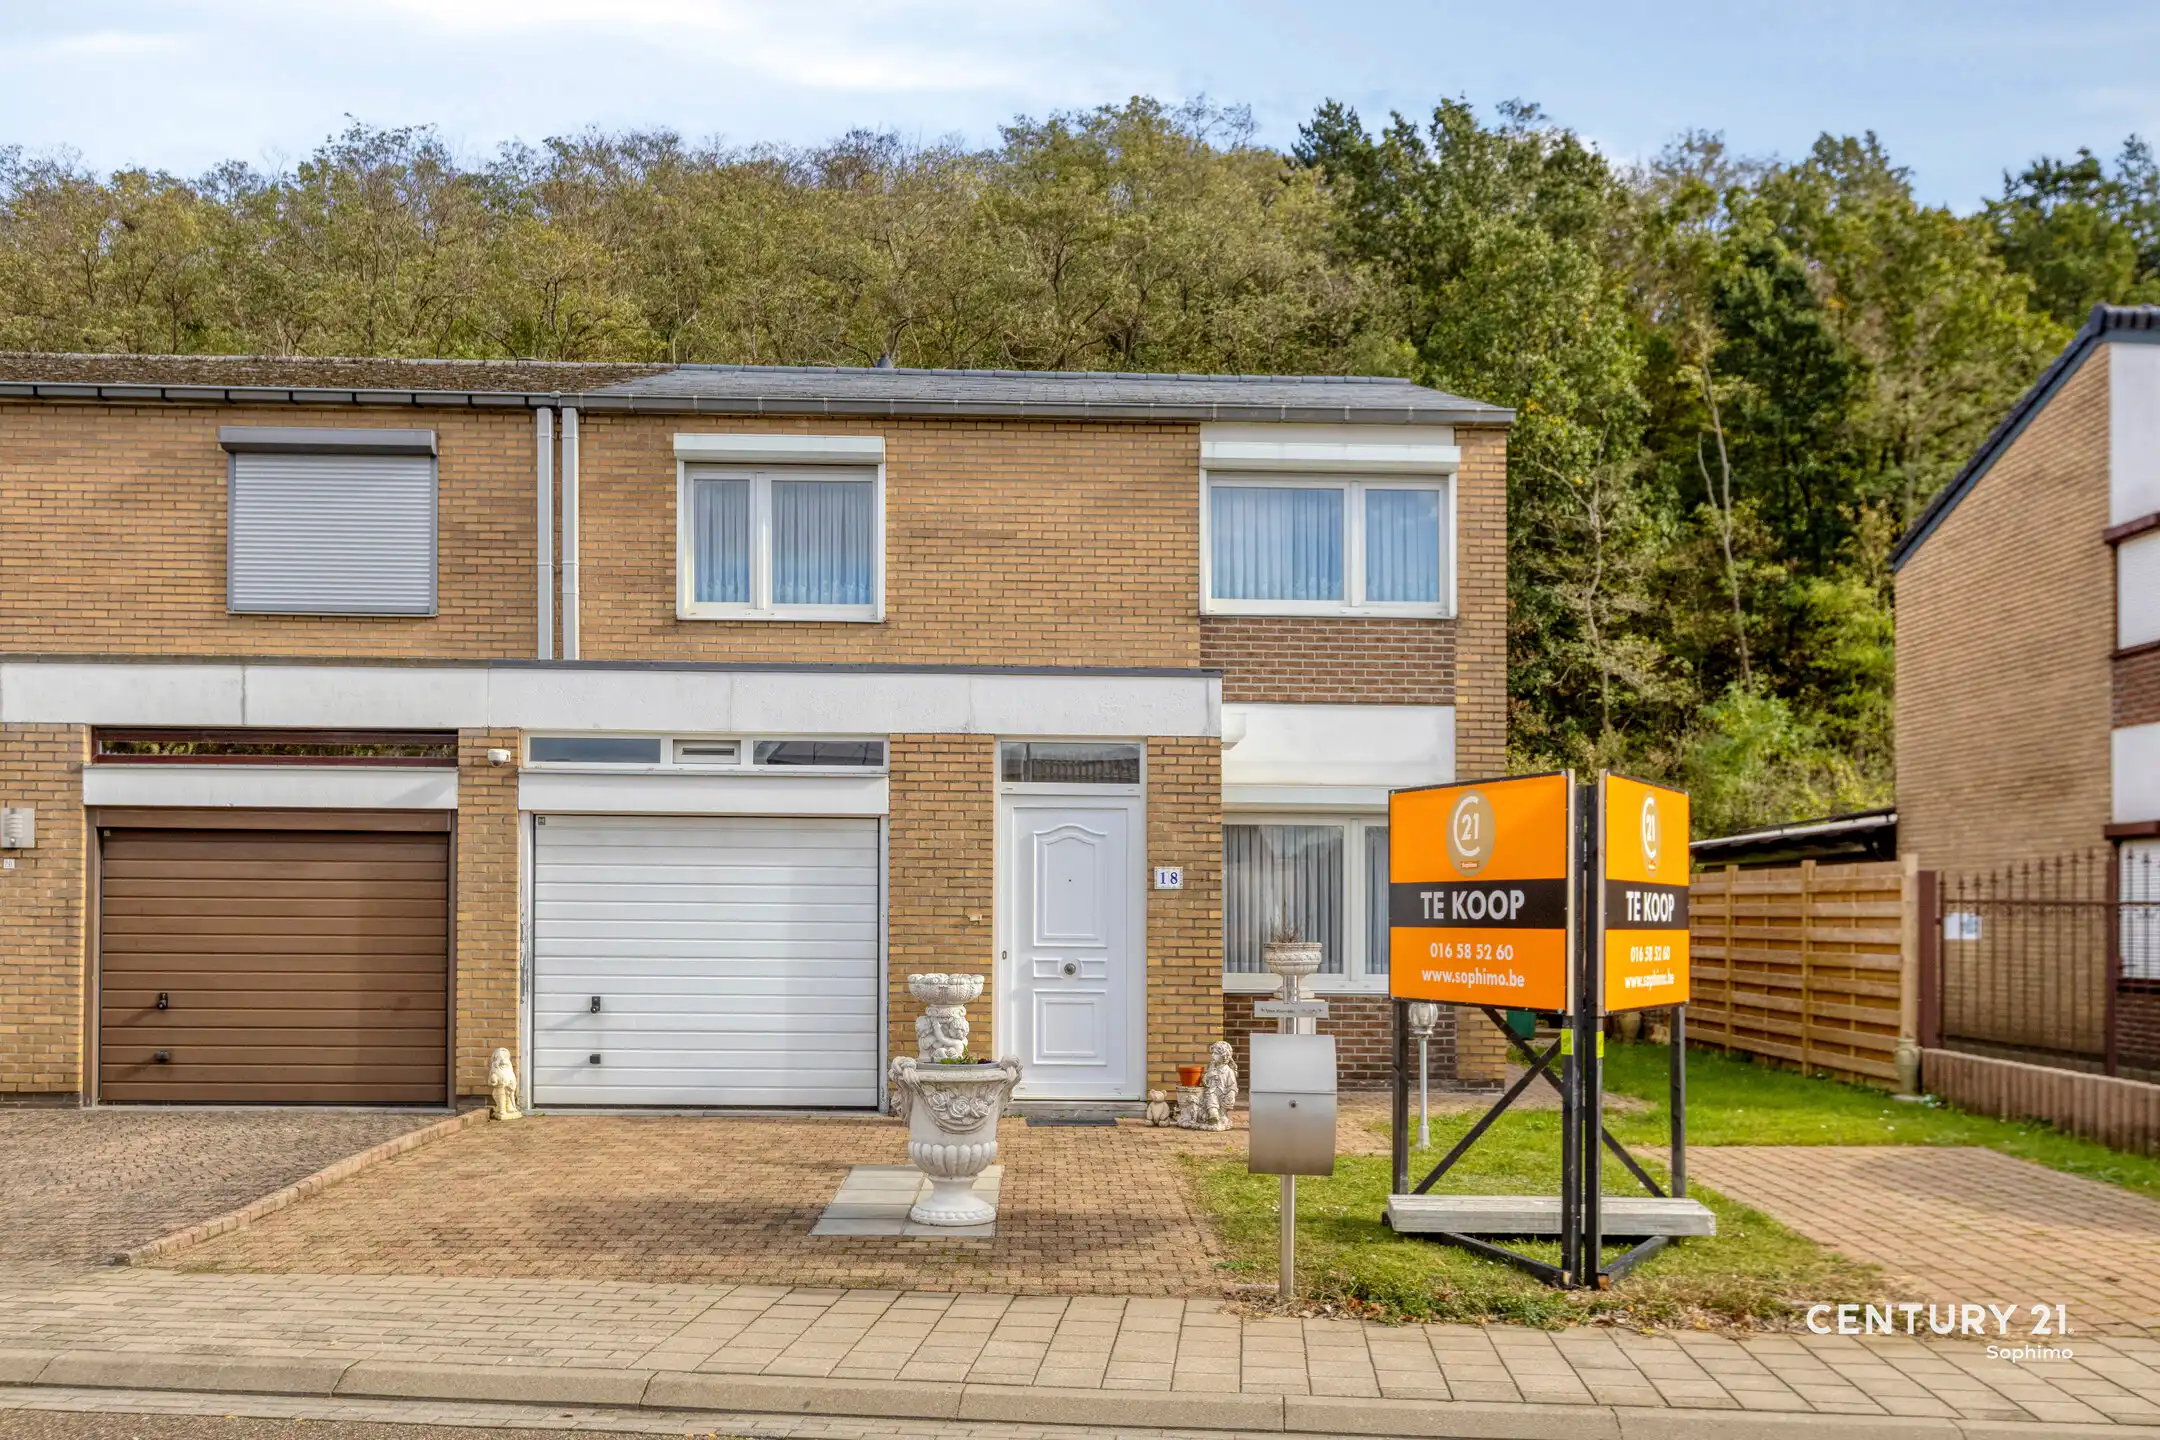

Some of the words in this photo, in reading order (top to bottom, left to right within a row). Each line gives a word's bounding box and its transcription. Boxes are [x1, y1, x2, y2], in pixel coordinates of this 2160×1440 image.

[1160, 871, 1178, 885] 18
[1420, 891, 1444, 919] TE
[1452, 889, 1525, 920] KOOP
[1626, 890, 1641, 922] TE
[1643, 891, 1675, 922] KOOP
[1430, 942, 1453, 958] 016
[1456, 943, 1472, 959] 58
[1476, 943, 1492, 960] 52
[1496, 943, 1514, 961] 60
[1630, 945, 1644, 962] 016
[1421, 967, 1525, 989] www.sophimo.be
